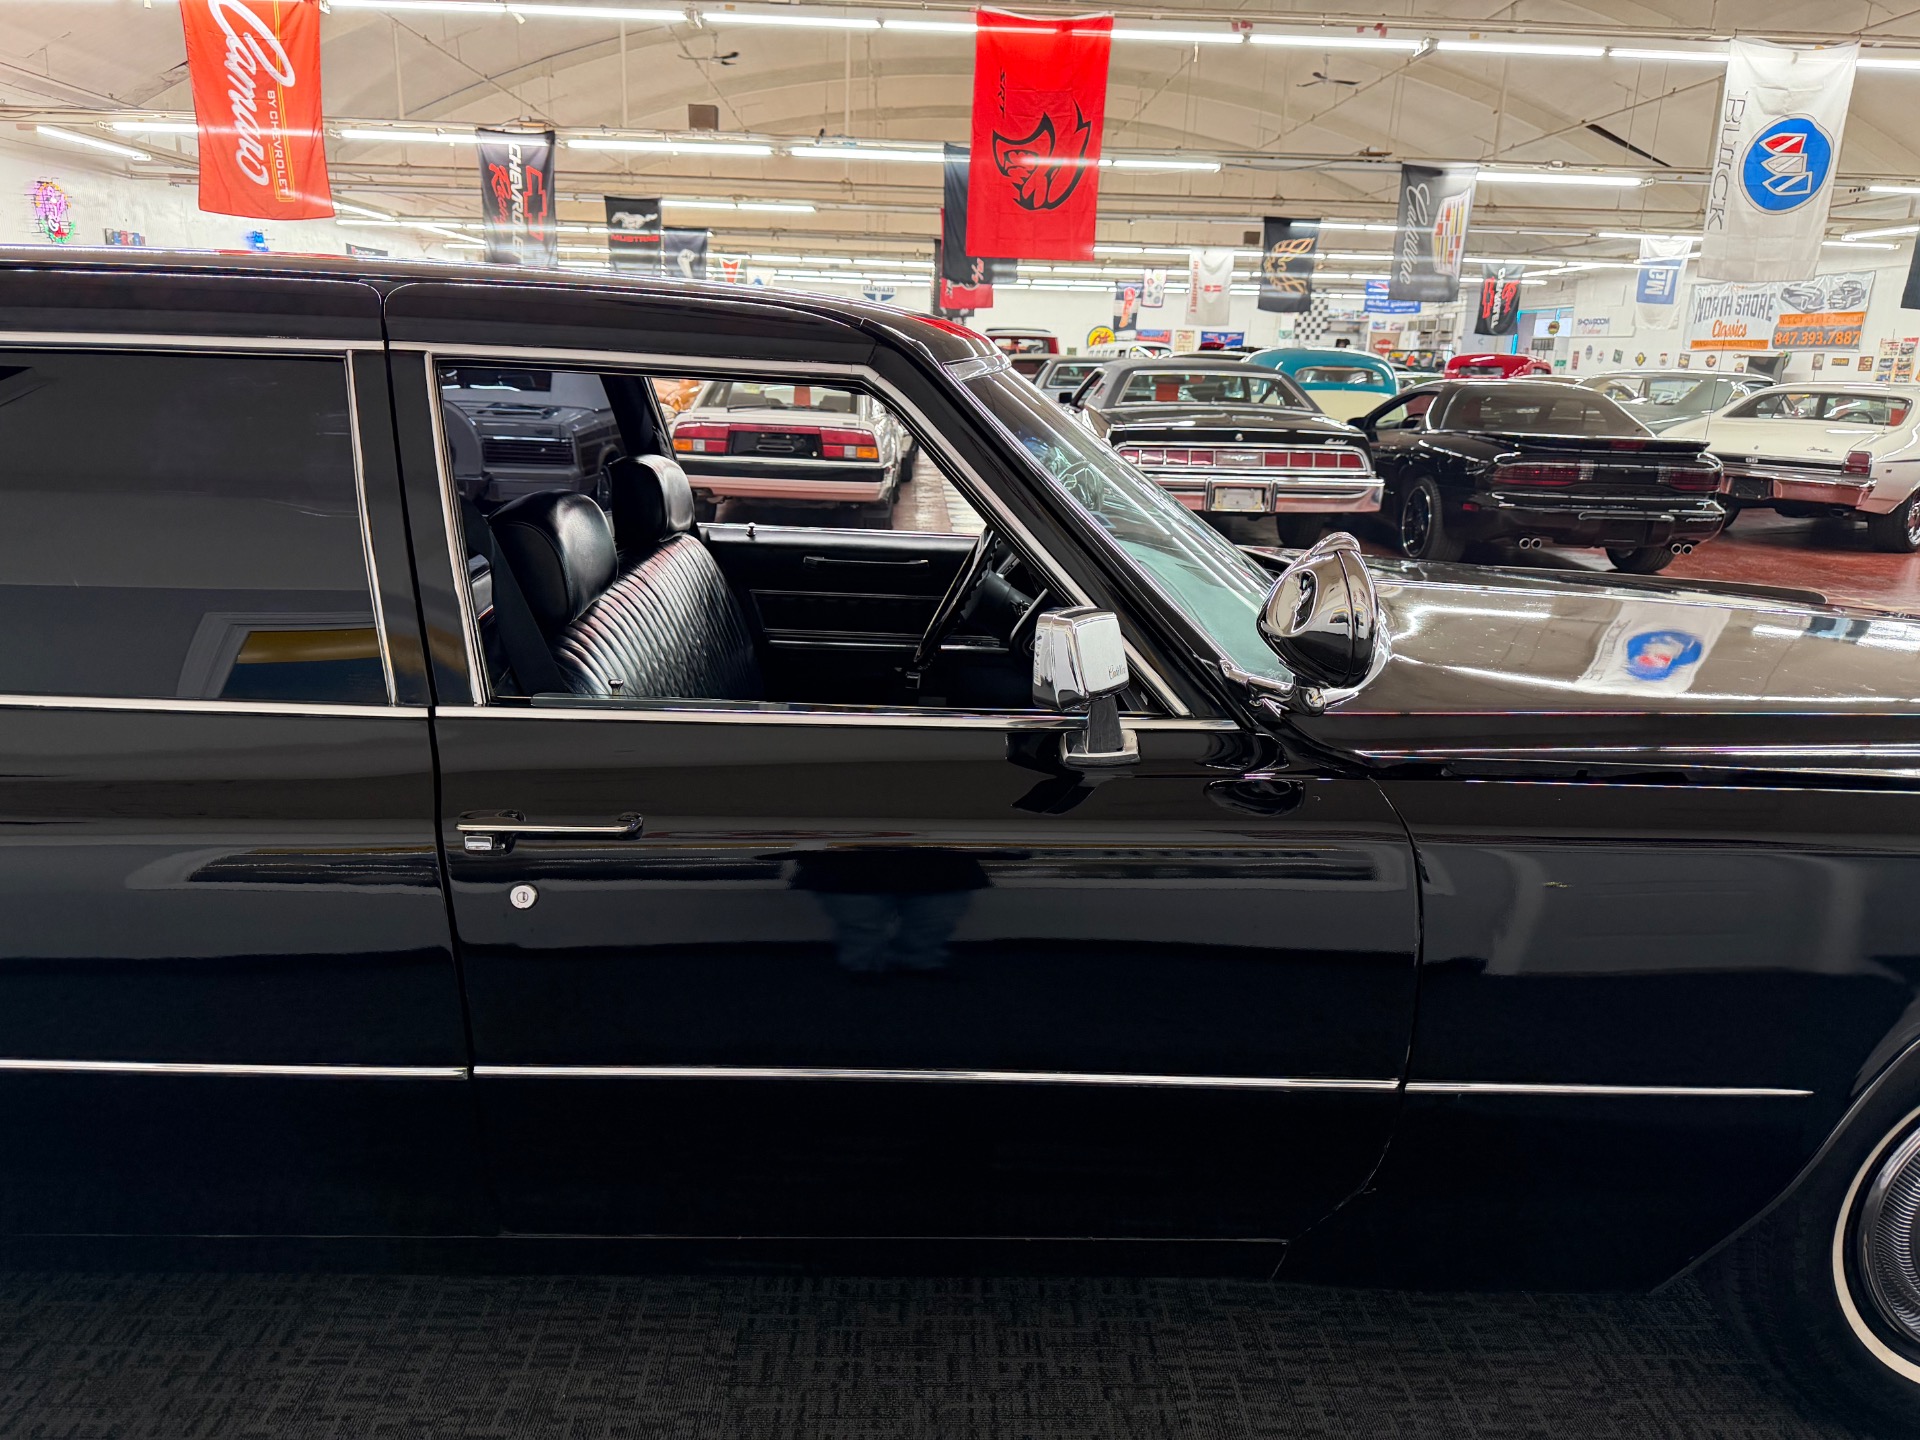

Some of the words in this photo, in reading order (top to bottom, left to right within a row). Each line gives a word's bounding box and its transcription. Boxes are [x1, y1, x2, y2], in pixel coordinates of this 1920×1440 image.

[207, 0, 296, 187] Camaro
[266, 90, 279, 107] BY
[268, 110, 289, 196] CHEVROLET
[1708, 90, 1749, 231] BUICK
[610, 233, 660, 243] MUSTANG
[1399, 182, 1431, 285] Cadillac
[1693, 295, 1732, 325] NORTH
[1734, 292, 1776, 322] SHORE
[1711, 319, 1748, 338] Classics
[1774, 330, 1863, 346] 847.393.7887
